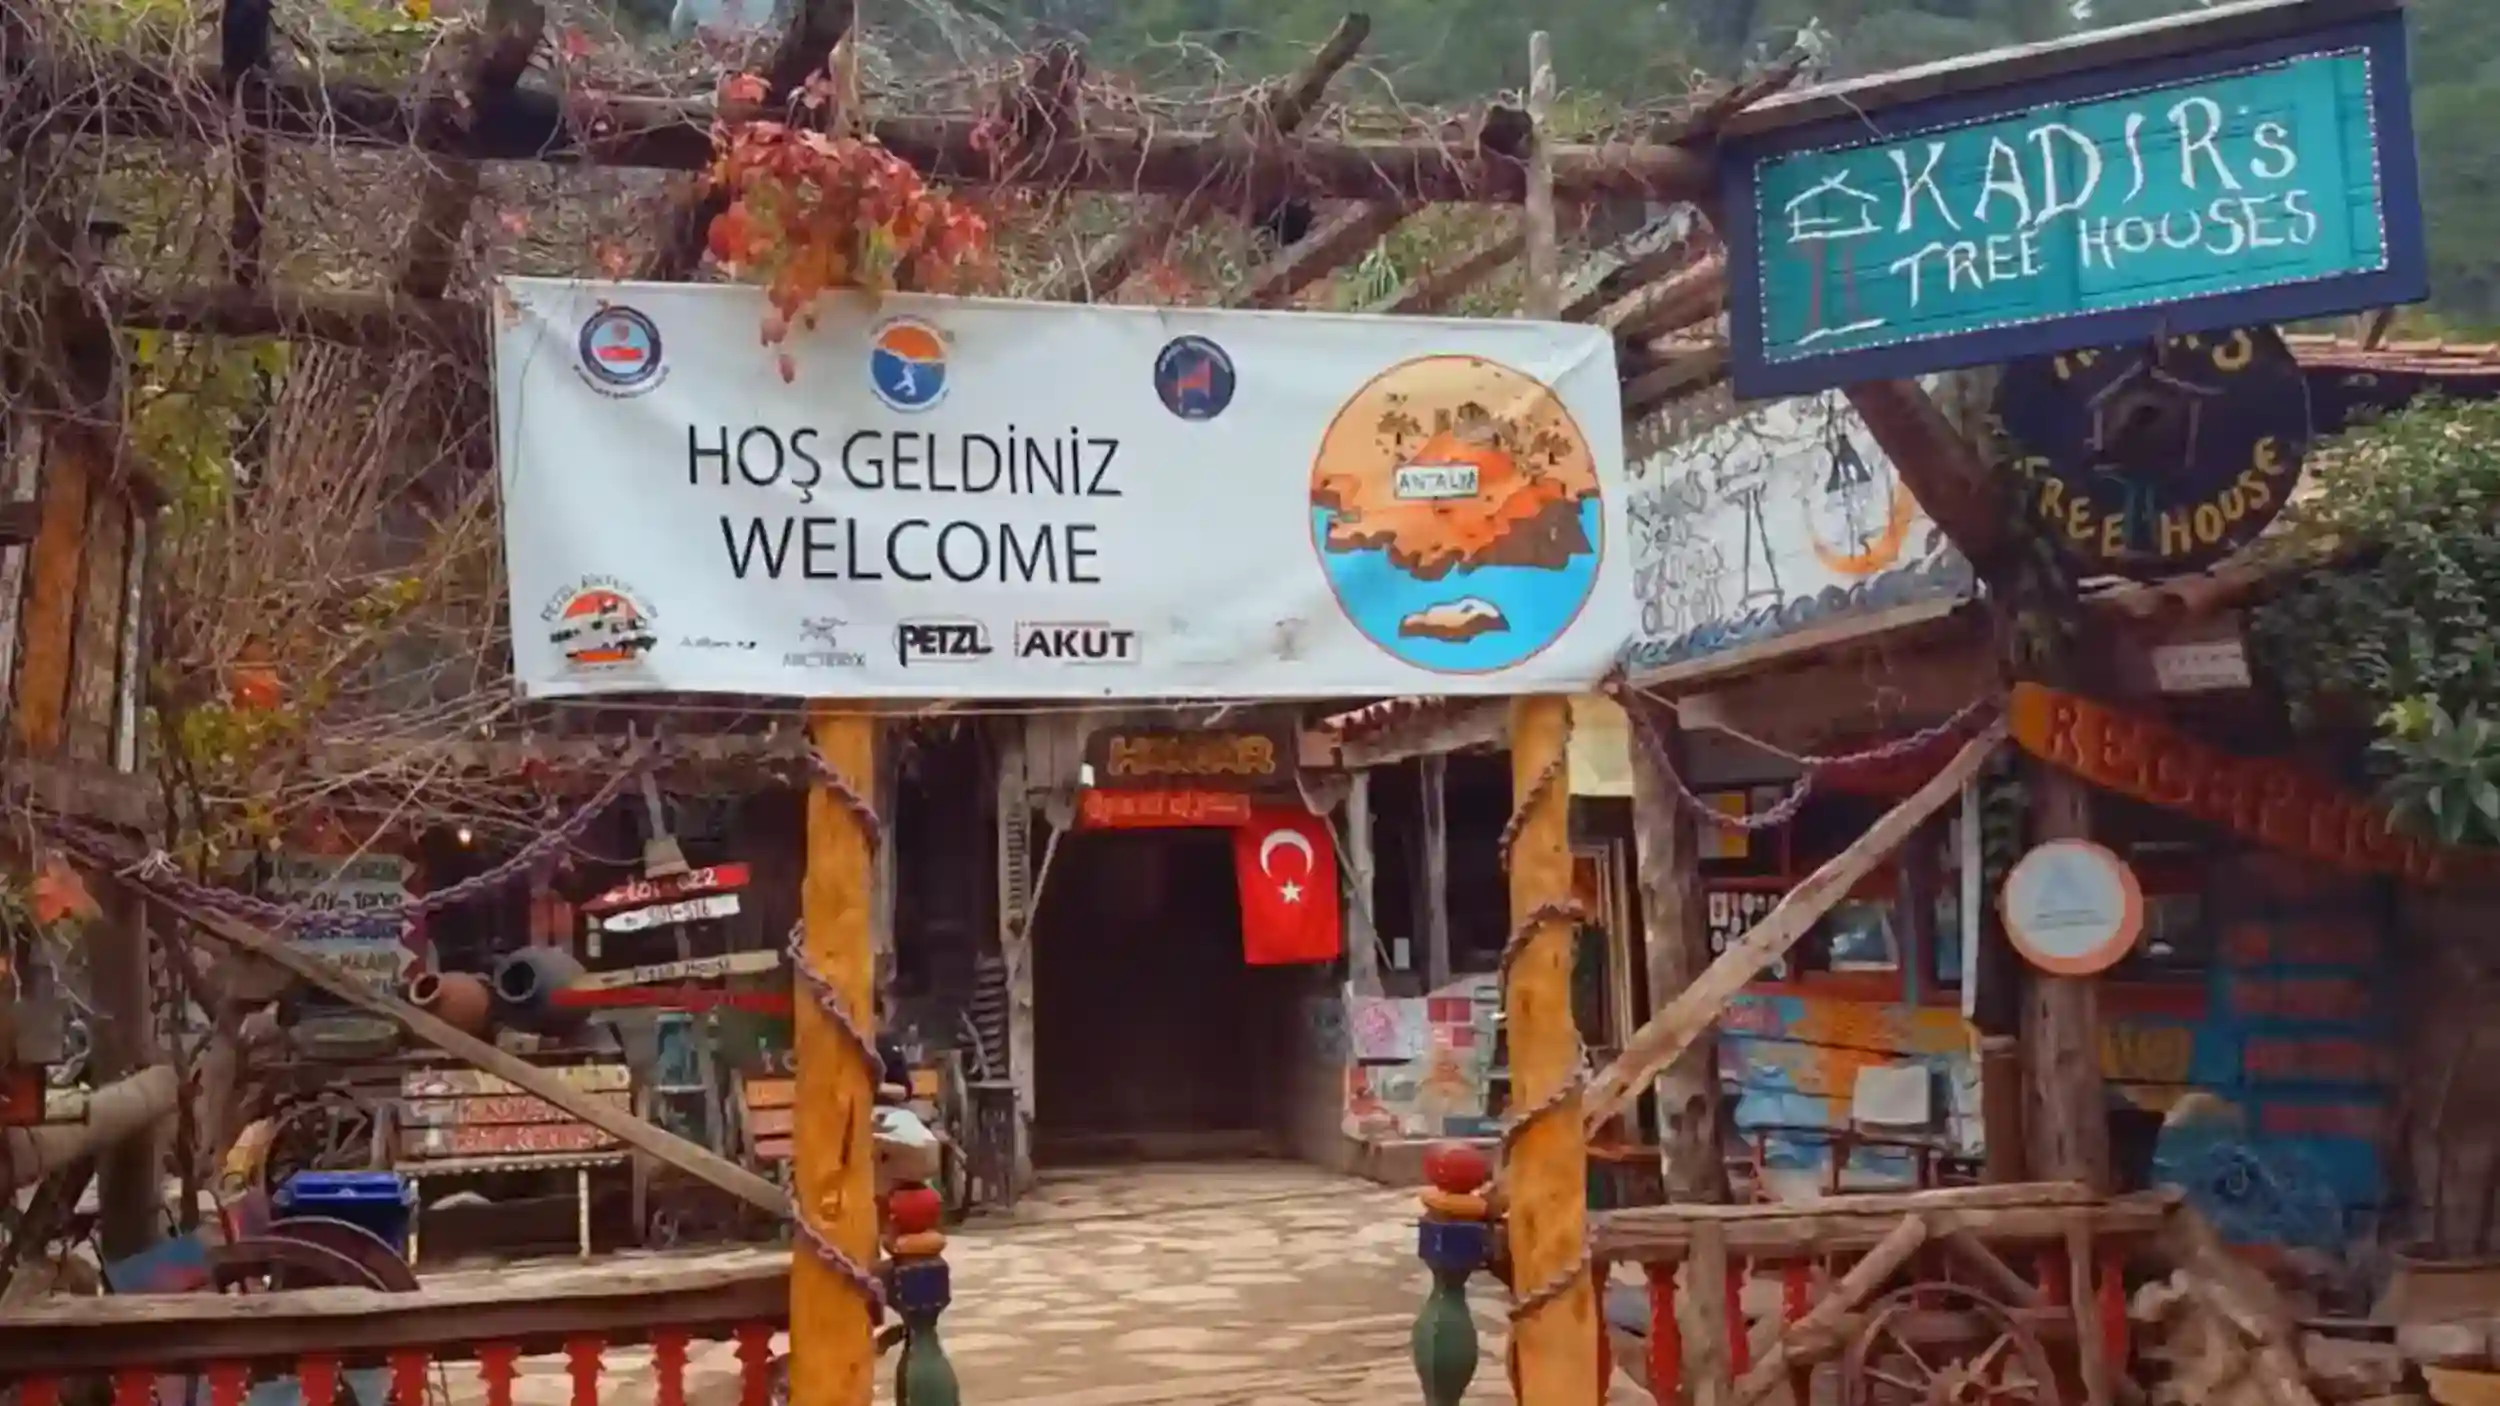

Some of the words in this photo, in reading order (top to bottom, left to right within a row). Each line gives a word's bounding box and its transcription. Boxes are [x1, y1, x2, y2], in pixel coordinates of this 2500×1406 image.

[1889, 222, 2042, 308] TREE
[2078, 189, 2317, 270] HOUSES
[688, 424, 822, 504] HOŞ
[842, 422, 1121, 498] GELDİNİZ
[1399, 468, 1477, 492] ANTALYA
[2160, 435, 2285, 556] HOUSE
[720, 514, 1102, 584] WELCOME
[898, 623, 994, 668] PETZL
[1022, 629, 1135, 659] AKUT
